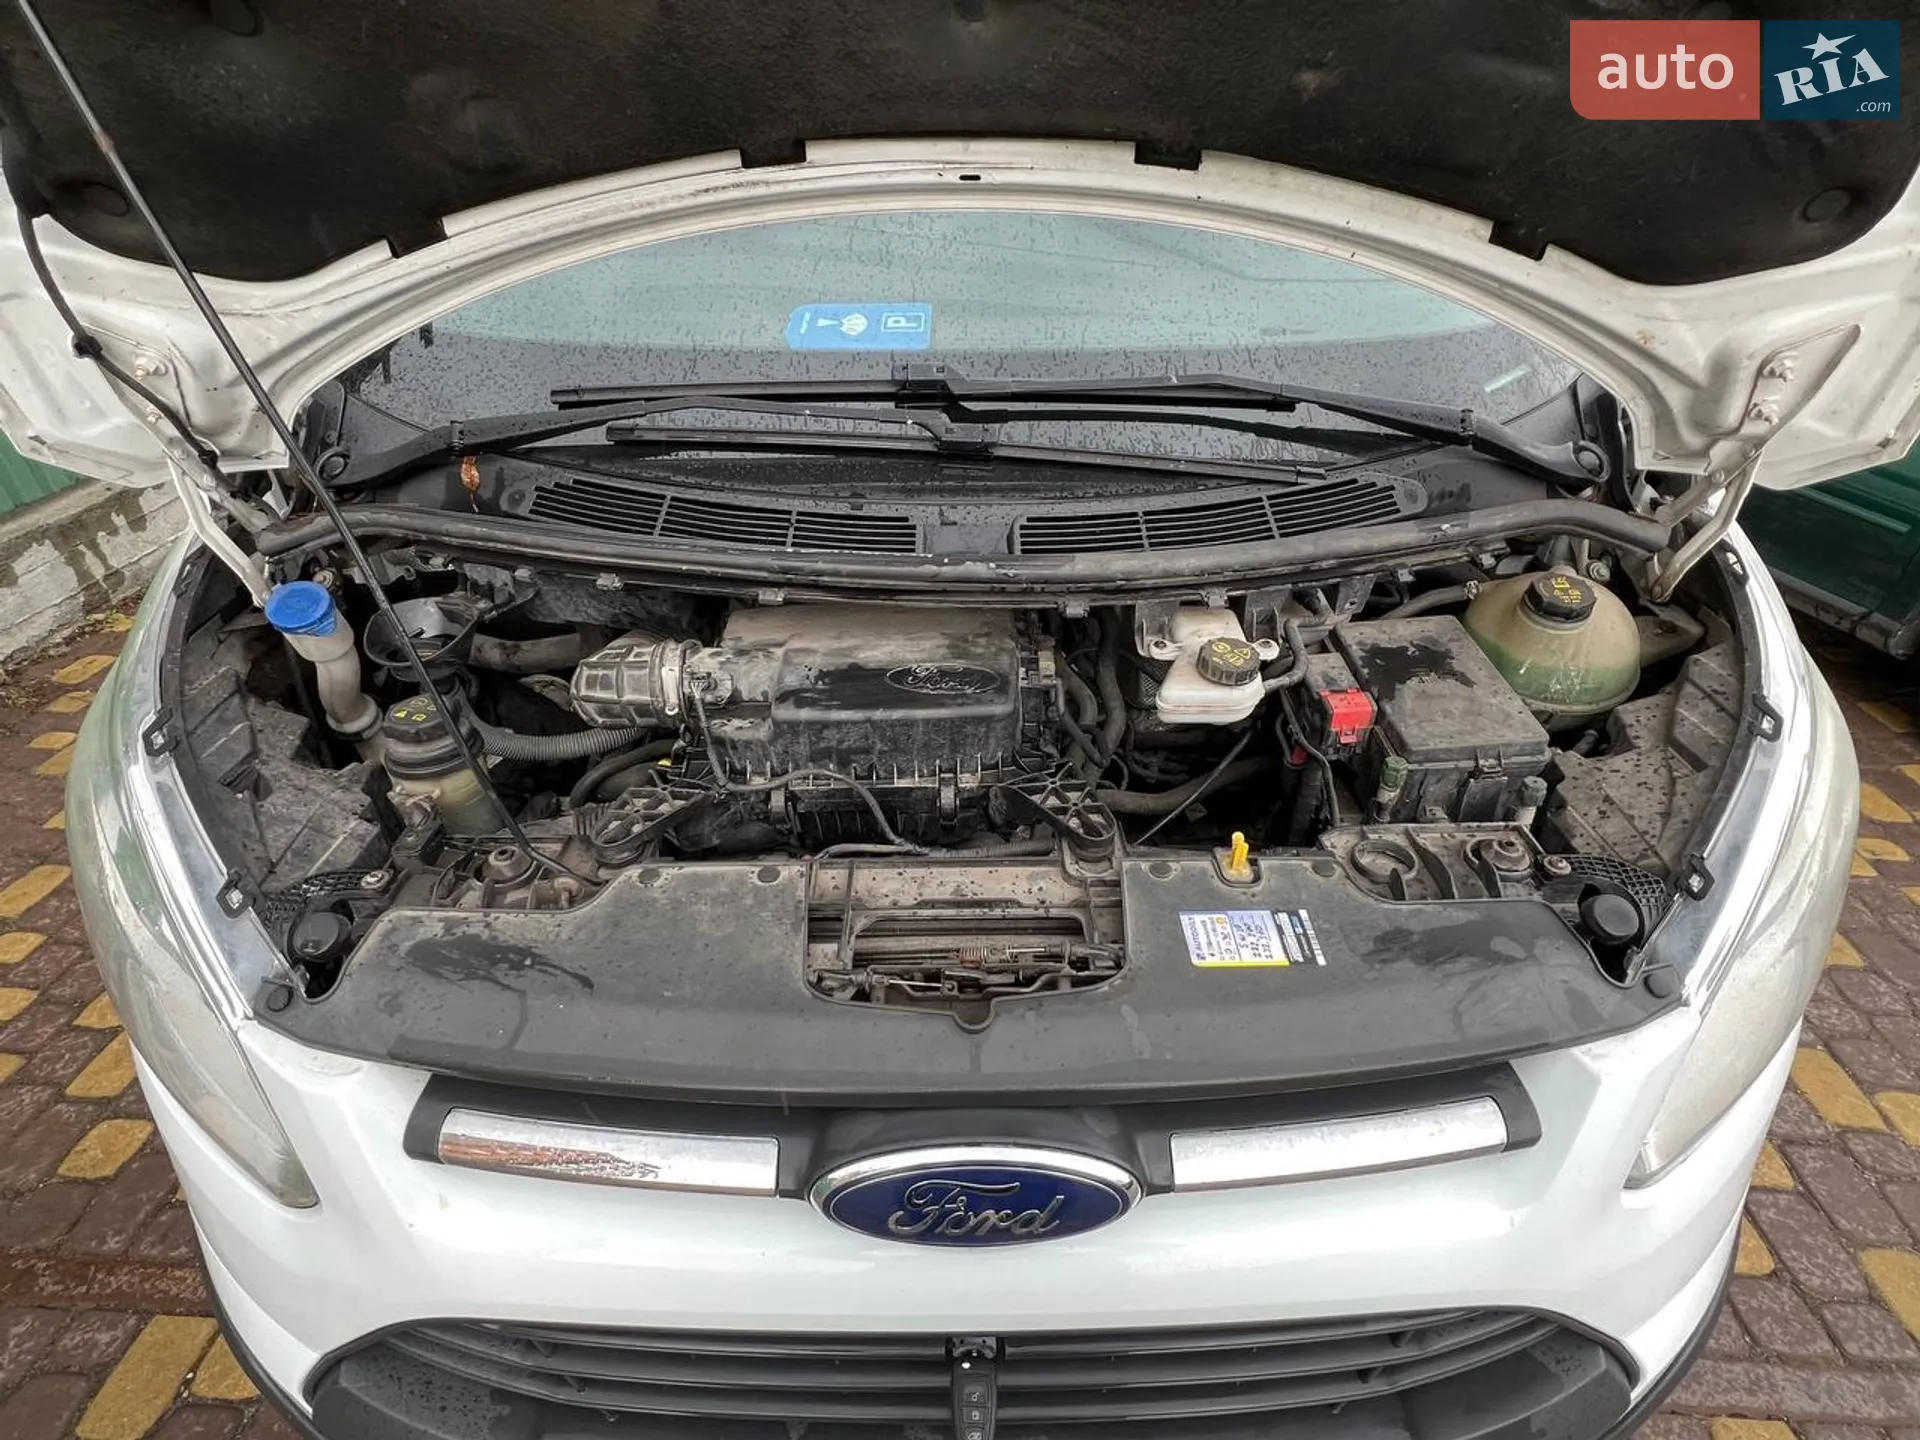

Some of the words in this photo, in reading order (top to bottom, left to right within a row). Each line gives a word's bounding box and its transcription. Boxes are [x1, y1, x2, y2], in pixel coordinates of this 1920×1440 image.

[886, 316, 918, 328] P
[904, 663, 990, 694] Ford
[888, 1179, 1065, 1236] Ford
